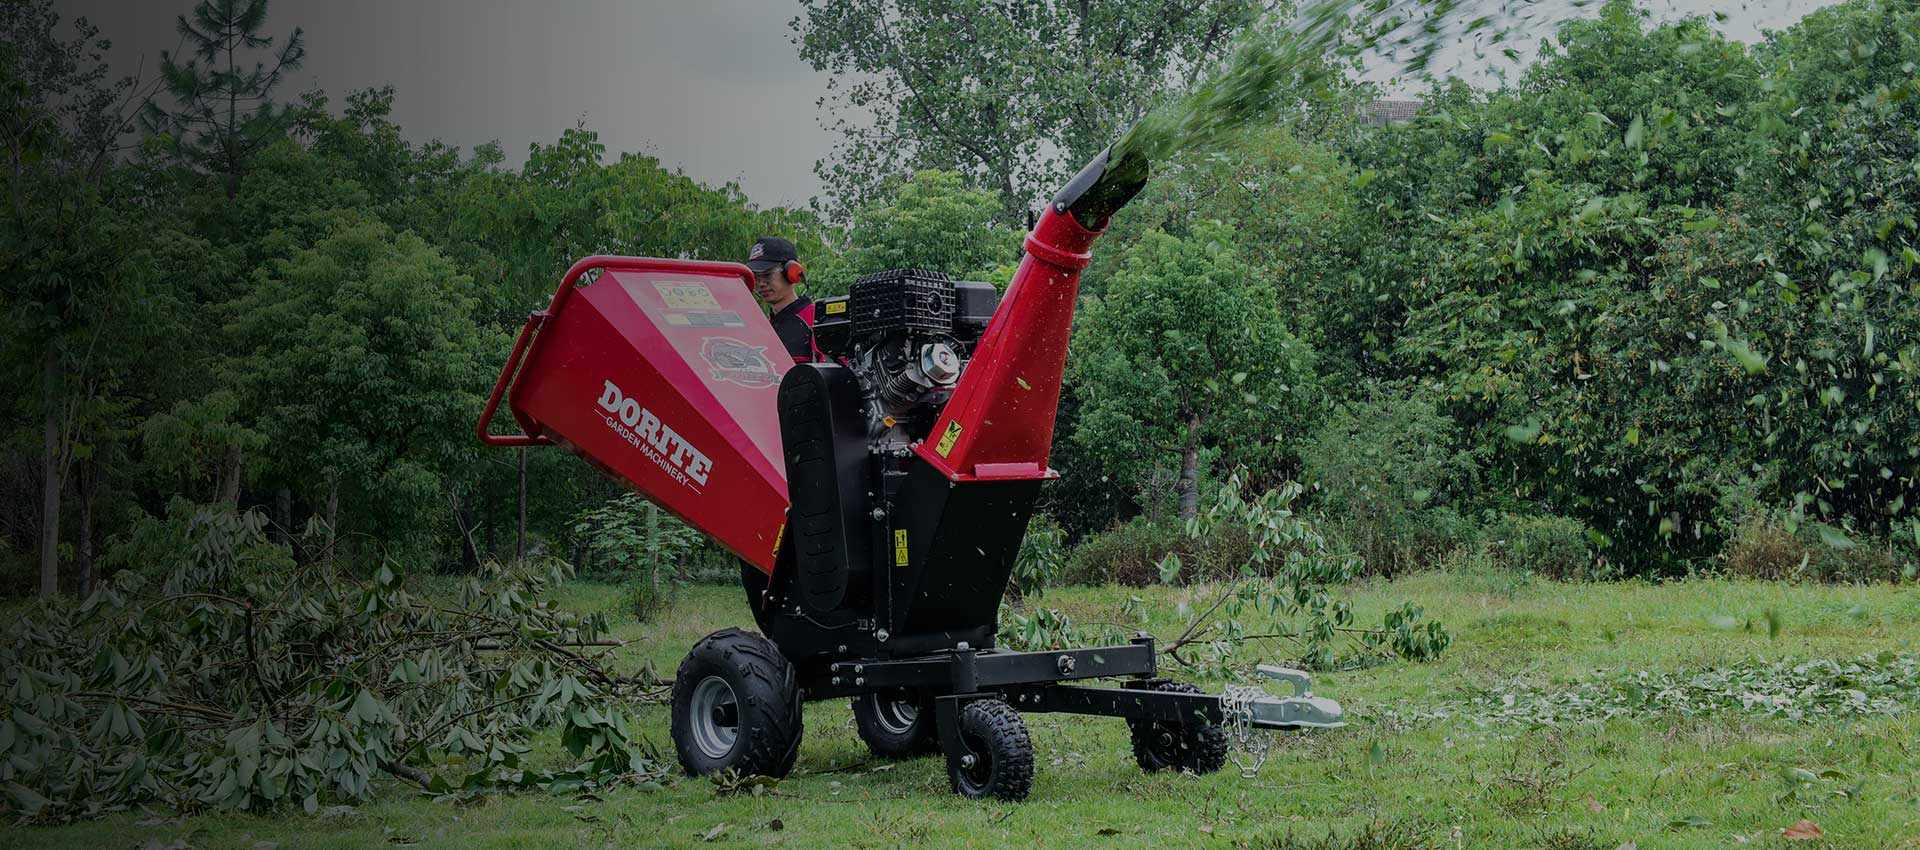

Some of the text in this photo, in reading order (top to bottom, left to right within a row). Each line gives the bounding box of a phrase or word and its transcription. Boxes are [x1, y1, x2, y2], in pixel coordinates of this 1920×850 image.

[597, 379, 713, 487] DORITE
[606, 416, 689, 486] GARDEN MACHINERY
